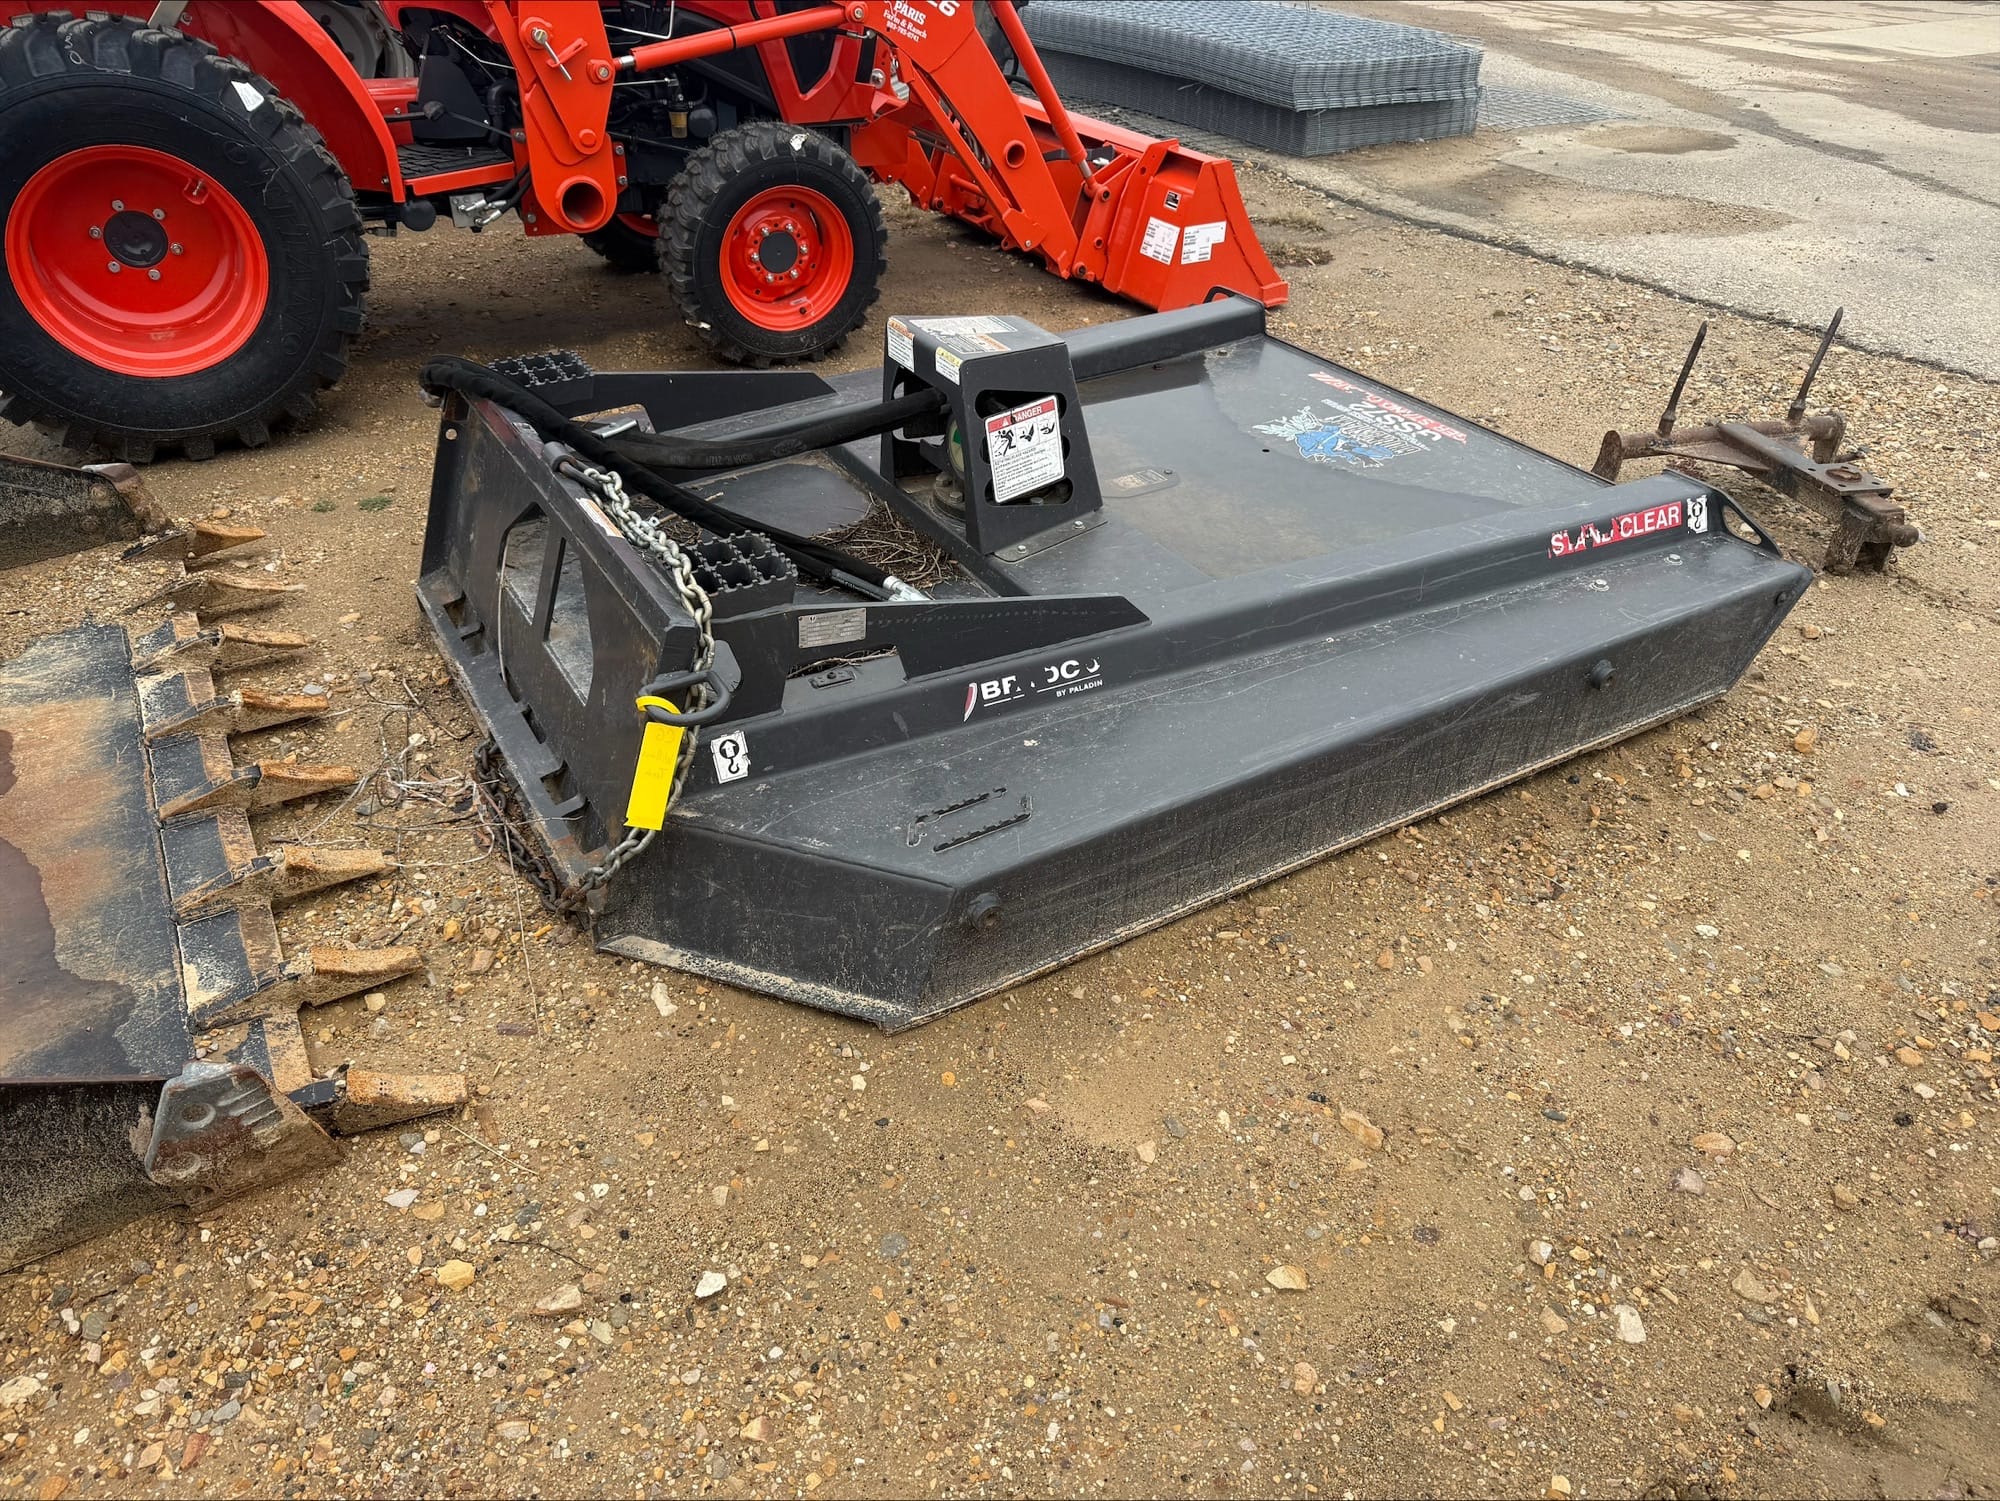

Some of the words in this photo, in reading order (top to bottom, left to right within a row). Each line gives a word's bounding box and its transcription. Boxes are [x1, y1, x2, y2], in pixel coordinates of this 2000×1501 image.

[883, 9, 901, 25] Farm
[906, 22, 927, 39] Ranch
[894, 0, 927, 26] PARIS
[1620, 505, 1680, 538] CLEAR
[1056, 689, 1066, 697] BY
[1069, 680, 1103, 694] PALADIN
